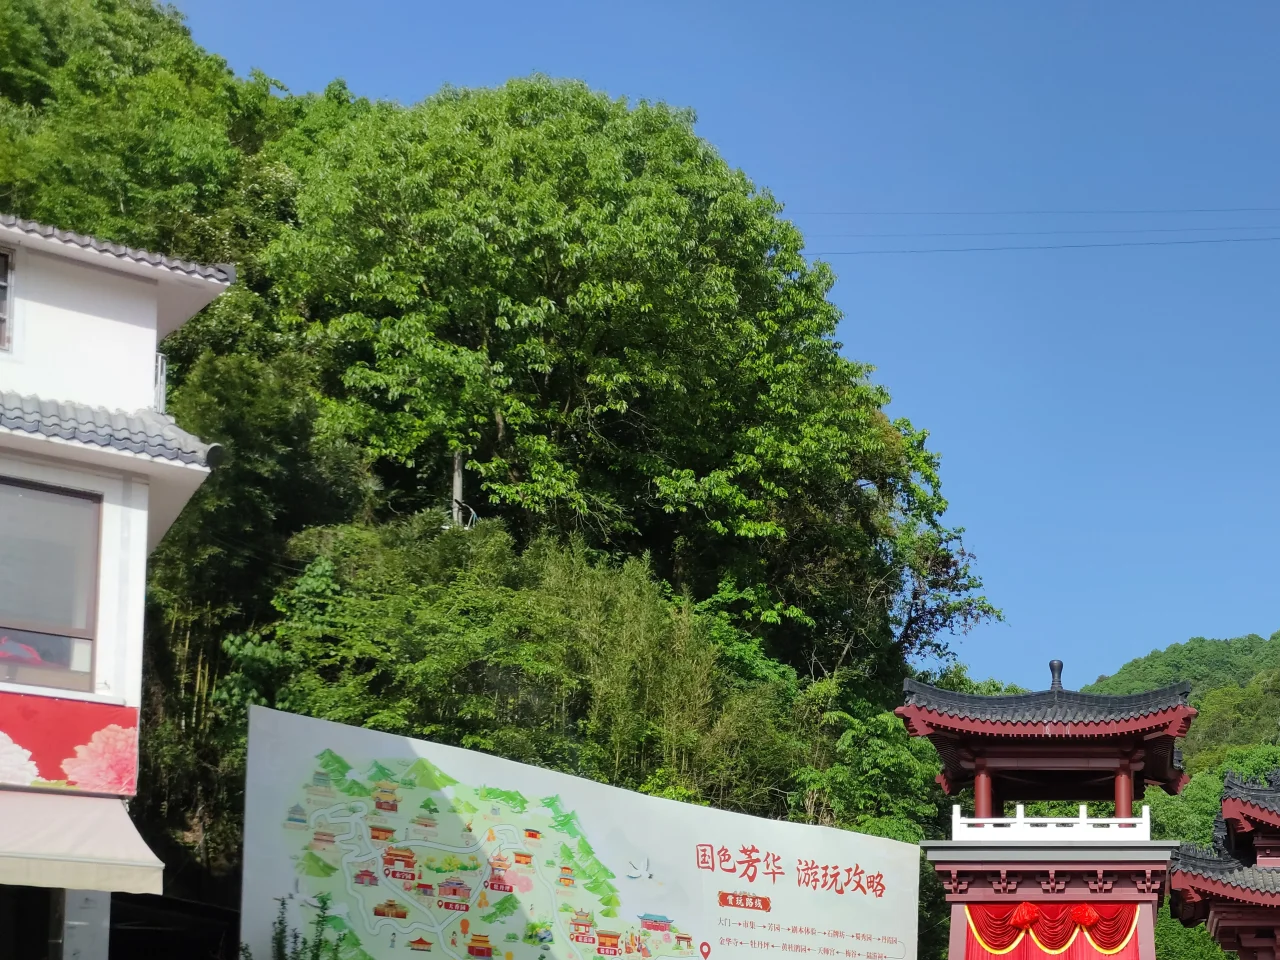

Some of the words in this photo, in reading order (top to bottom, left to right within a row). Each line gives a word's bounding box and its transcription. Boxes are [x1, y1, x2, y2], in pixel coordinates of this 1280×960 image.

[696, 844, 786, 884] 国色芳华
[797, 859, 886, 898] 游玩攻略
[718, 917, 731, 927] 大门
